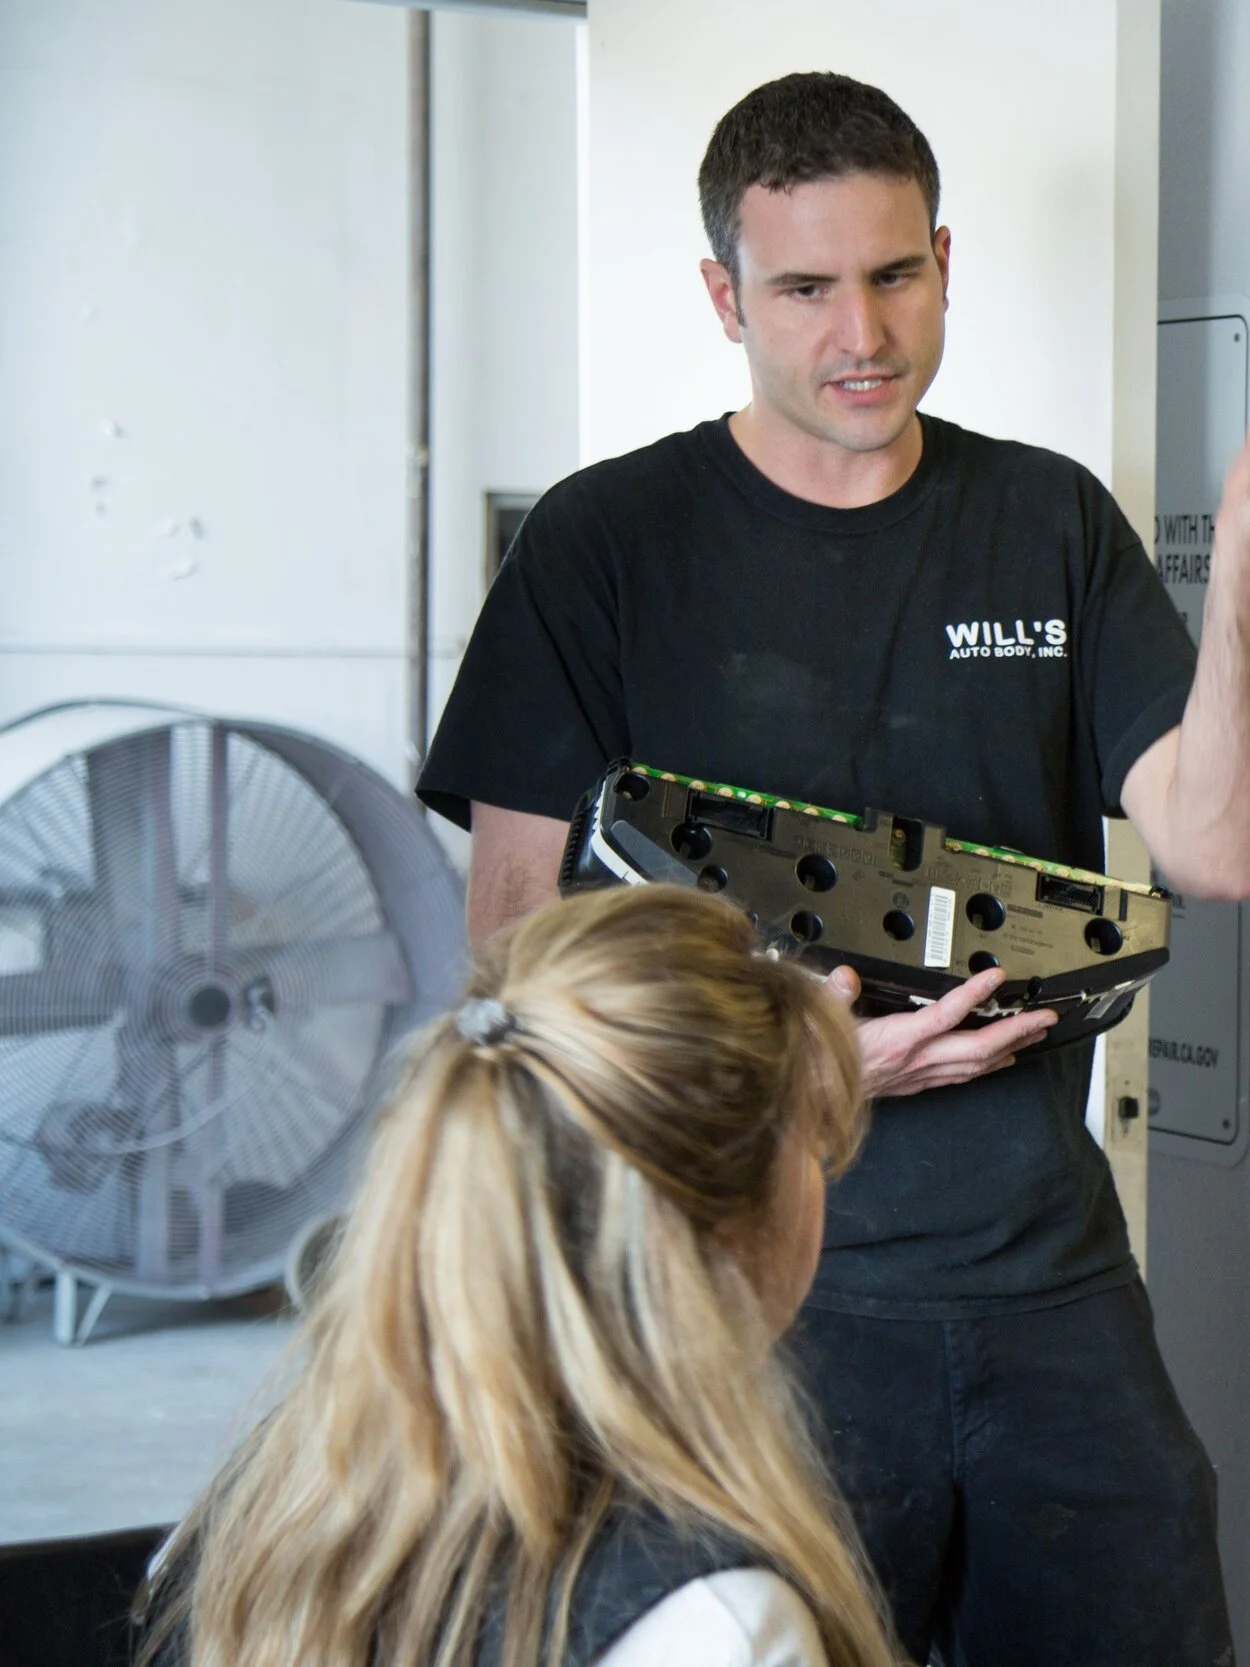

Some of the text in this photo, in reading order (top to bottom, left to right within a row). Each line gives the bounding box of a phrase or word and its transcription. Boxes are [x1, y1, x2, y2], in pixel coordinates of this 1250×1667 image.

[1164, 514, 1198, 545] WITH
[945, 618, 1067, 648] WILL'S
[949, 645, 1068, 660] AUTO BODY, INC.
